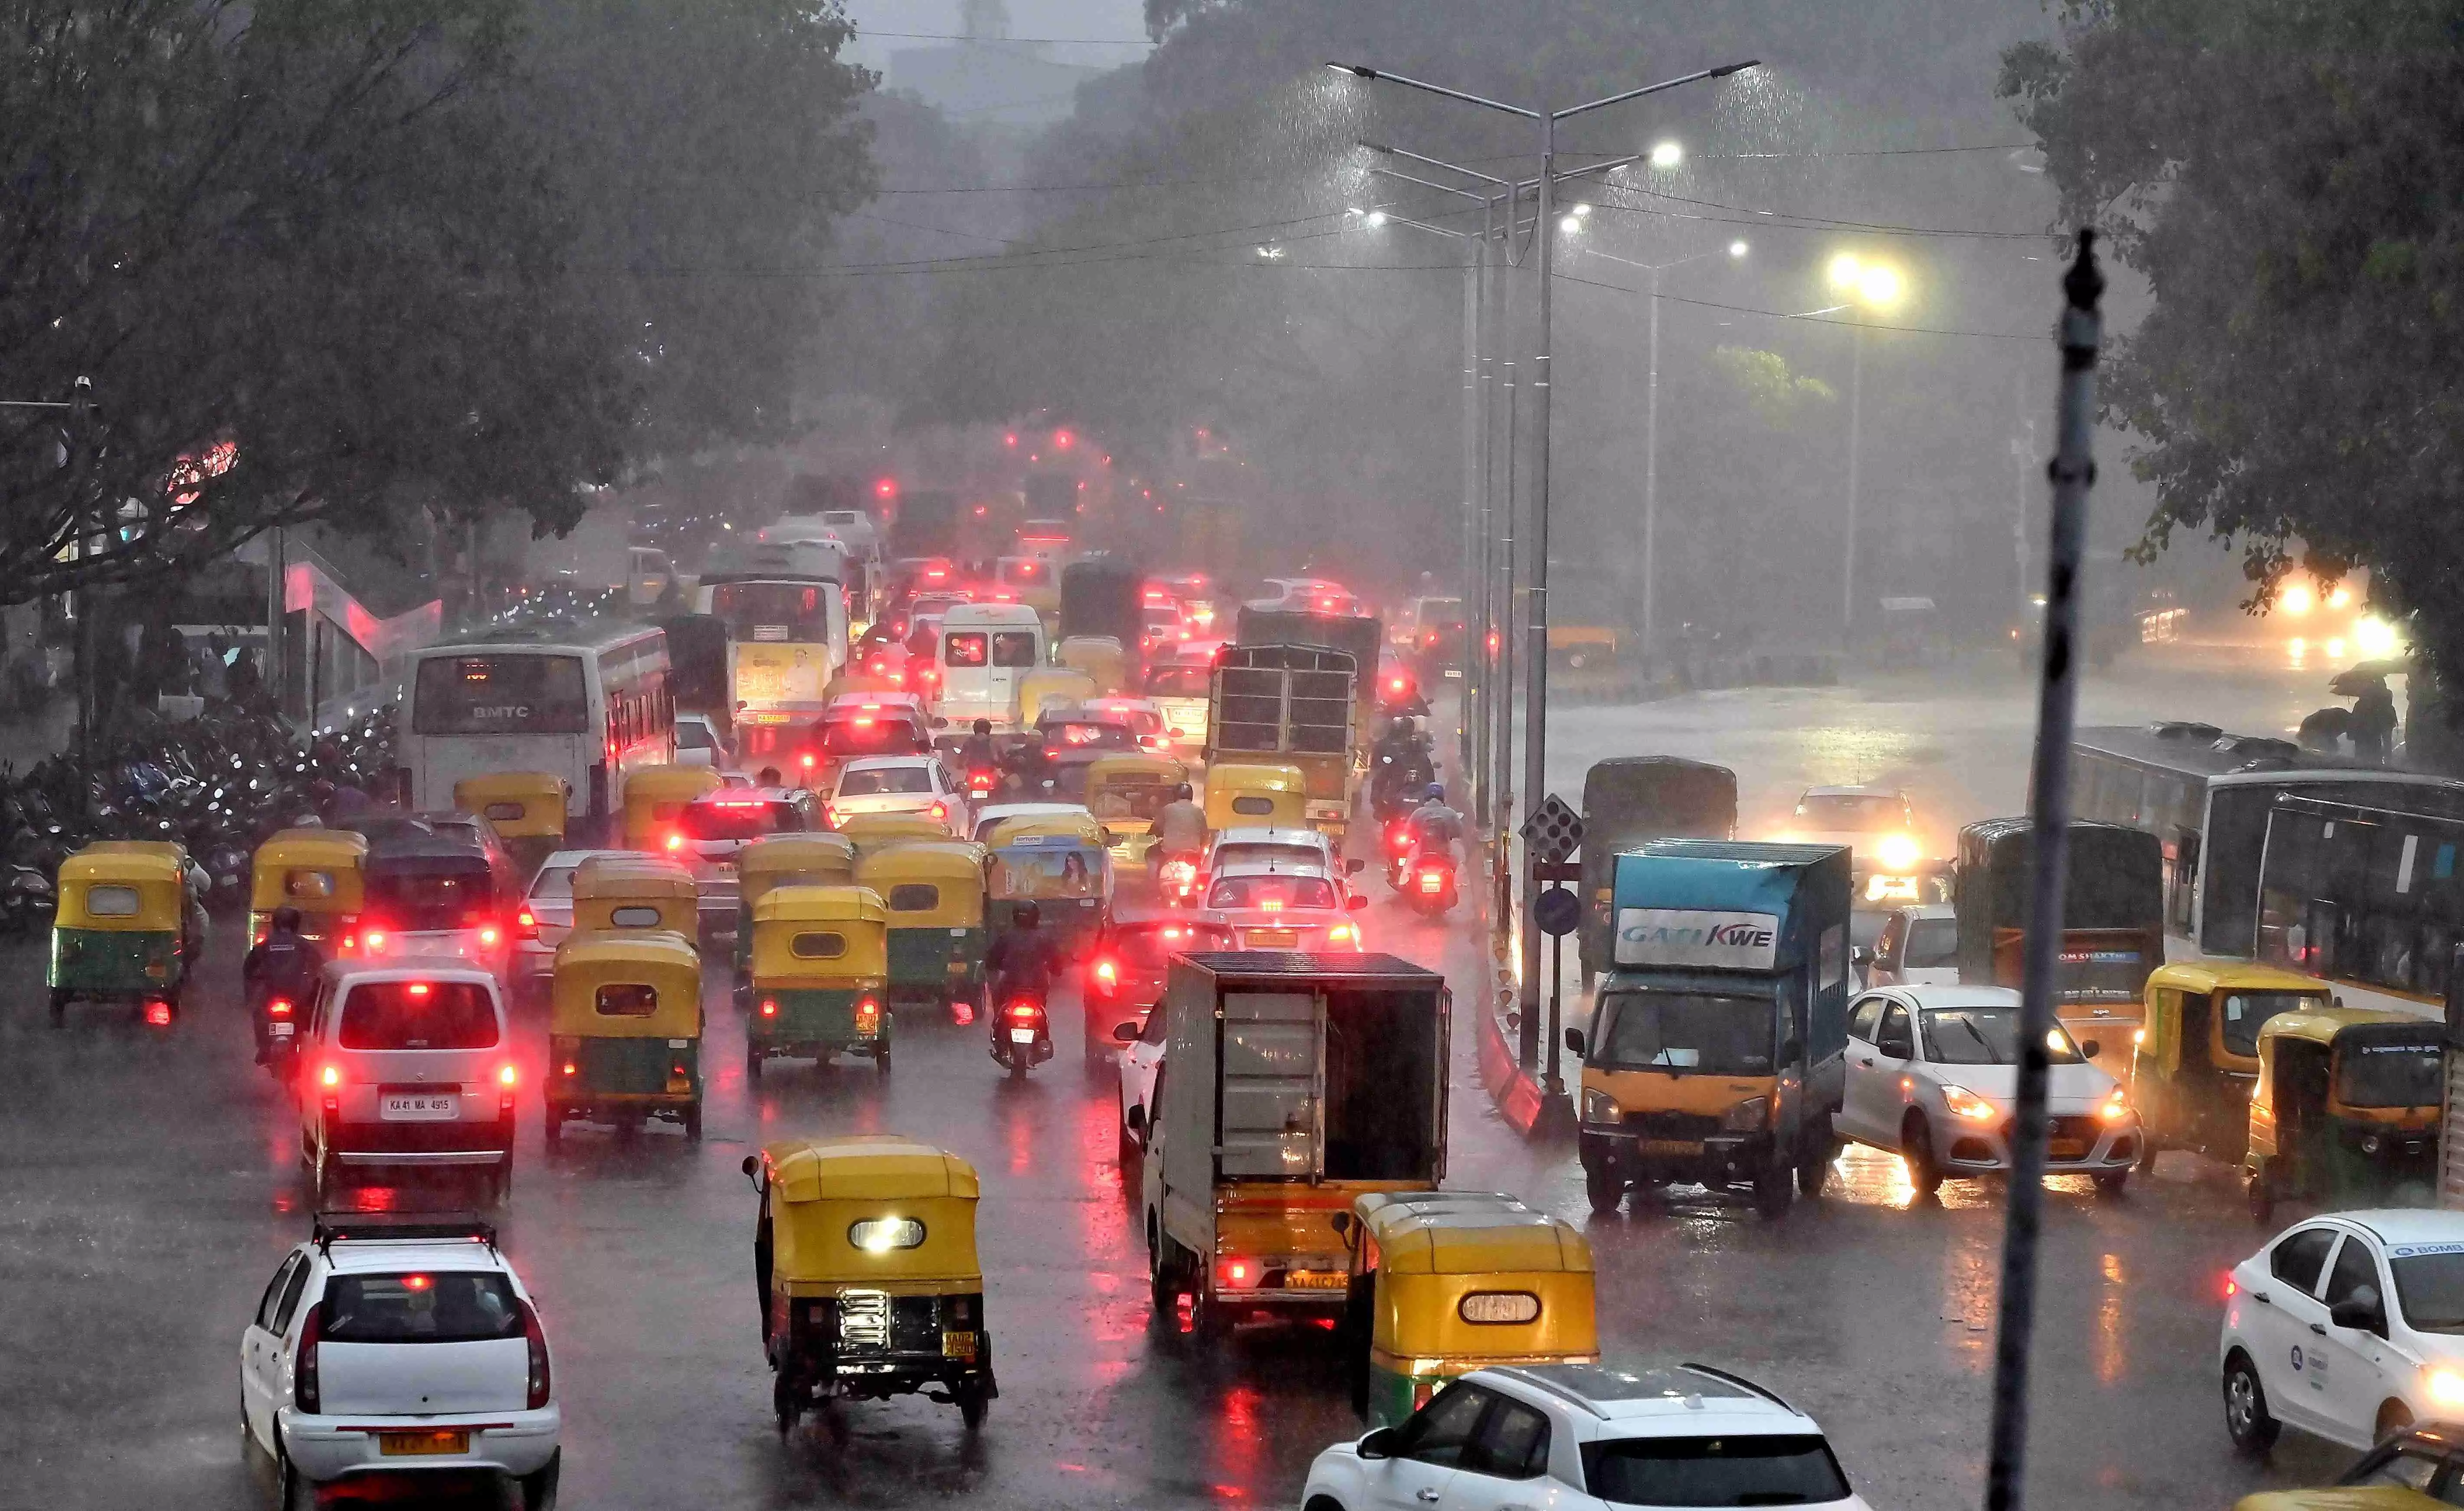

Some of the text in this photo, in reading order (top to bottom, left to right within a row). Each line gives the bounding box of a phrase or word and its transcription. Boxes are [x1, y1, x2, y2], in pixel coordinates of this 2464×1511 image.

[473, 706, 528, 718] BMTC
[1622, 923, 1773, 947] GATI KWE
[415, 1100, 426, 1110] MA
[431, 1100, 449, 1110] 4915
